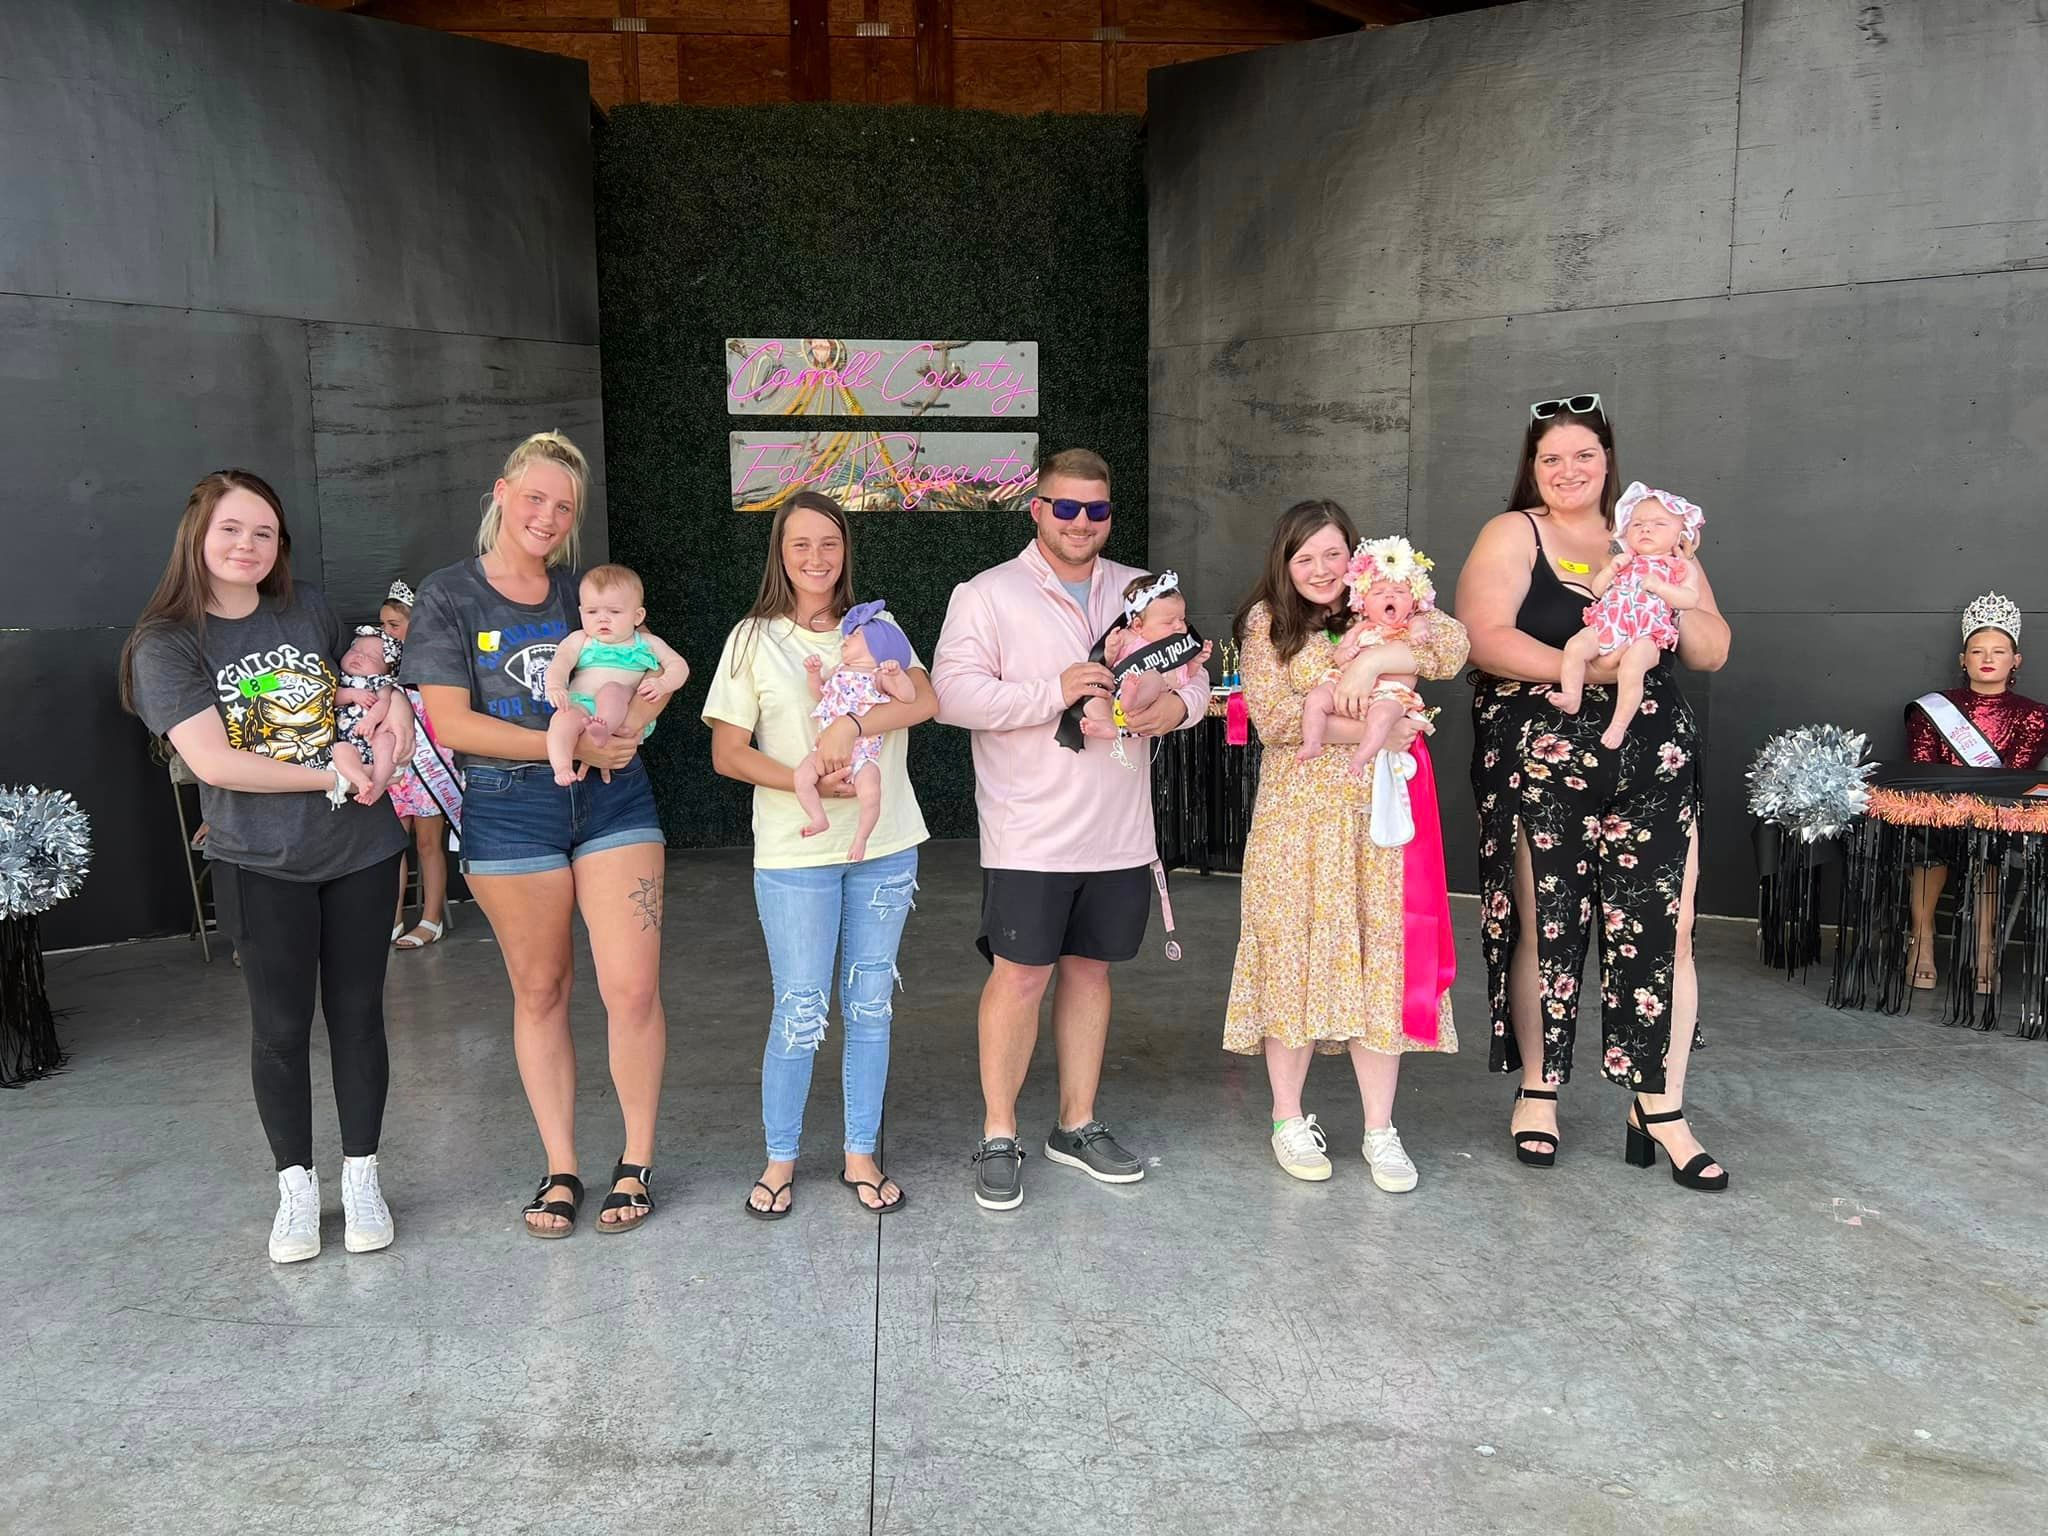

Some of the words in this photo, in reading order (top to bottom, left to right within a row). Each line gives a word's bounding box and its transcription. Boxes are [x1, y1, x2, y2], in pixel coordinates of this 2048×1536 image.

[729, 341, 880, 400] Carroll
[881, 343, 1034, 414] County
[732, 443, 842, 494] Fair
[849, 433, 1037, 510] Pageants
[217, 644, 321, 702] SENIORS
[249, 679, 260, 692] 8
